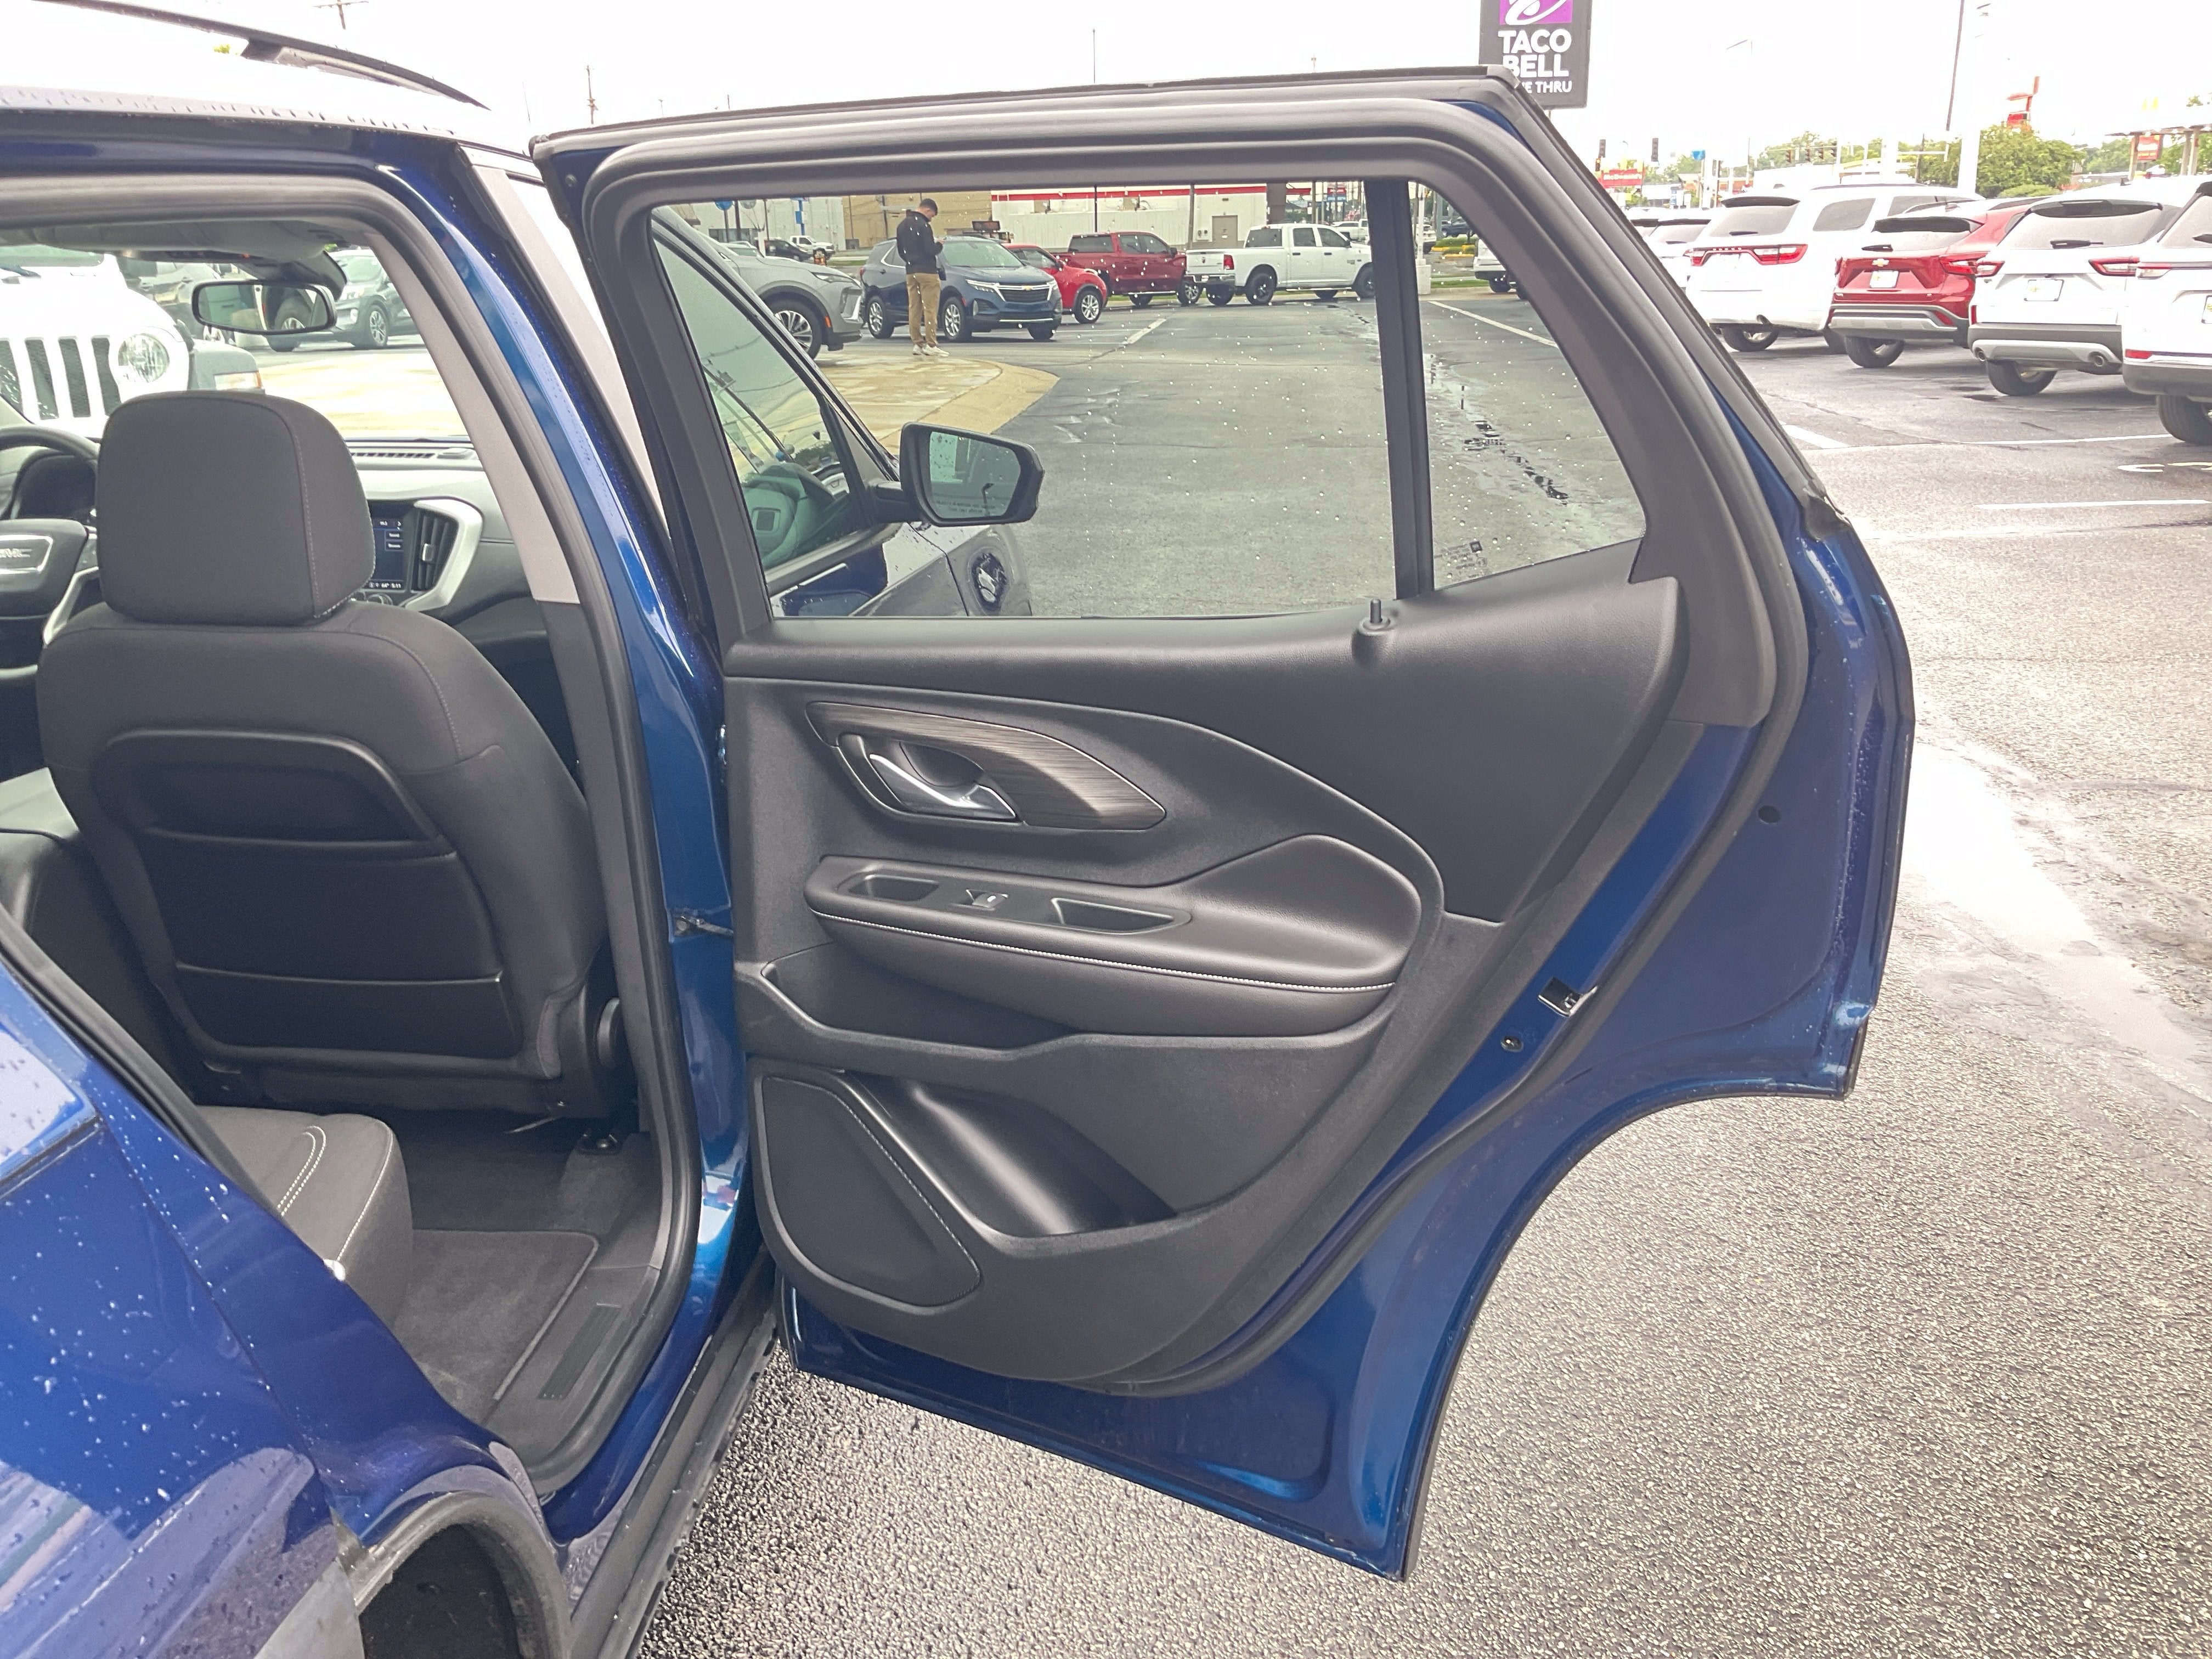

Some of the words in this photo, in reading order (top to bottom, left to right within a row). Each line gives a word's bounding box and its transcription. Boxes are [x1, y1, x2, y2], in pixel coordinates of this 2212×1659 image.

[1498, 29, 1572, 54] TACO
[1503, 54, 1569, 78] BELL
[1535, 81, 1572, 93] THRU
